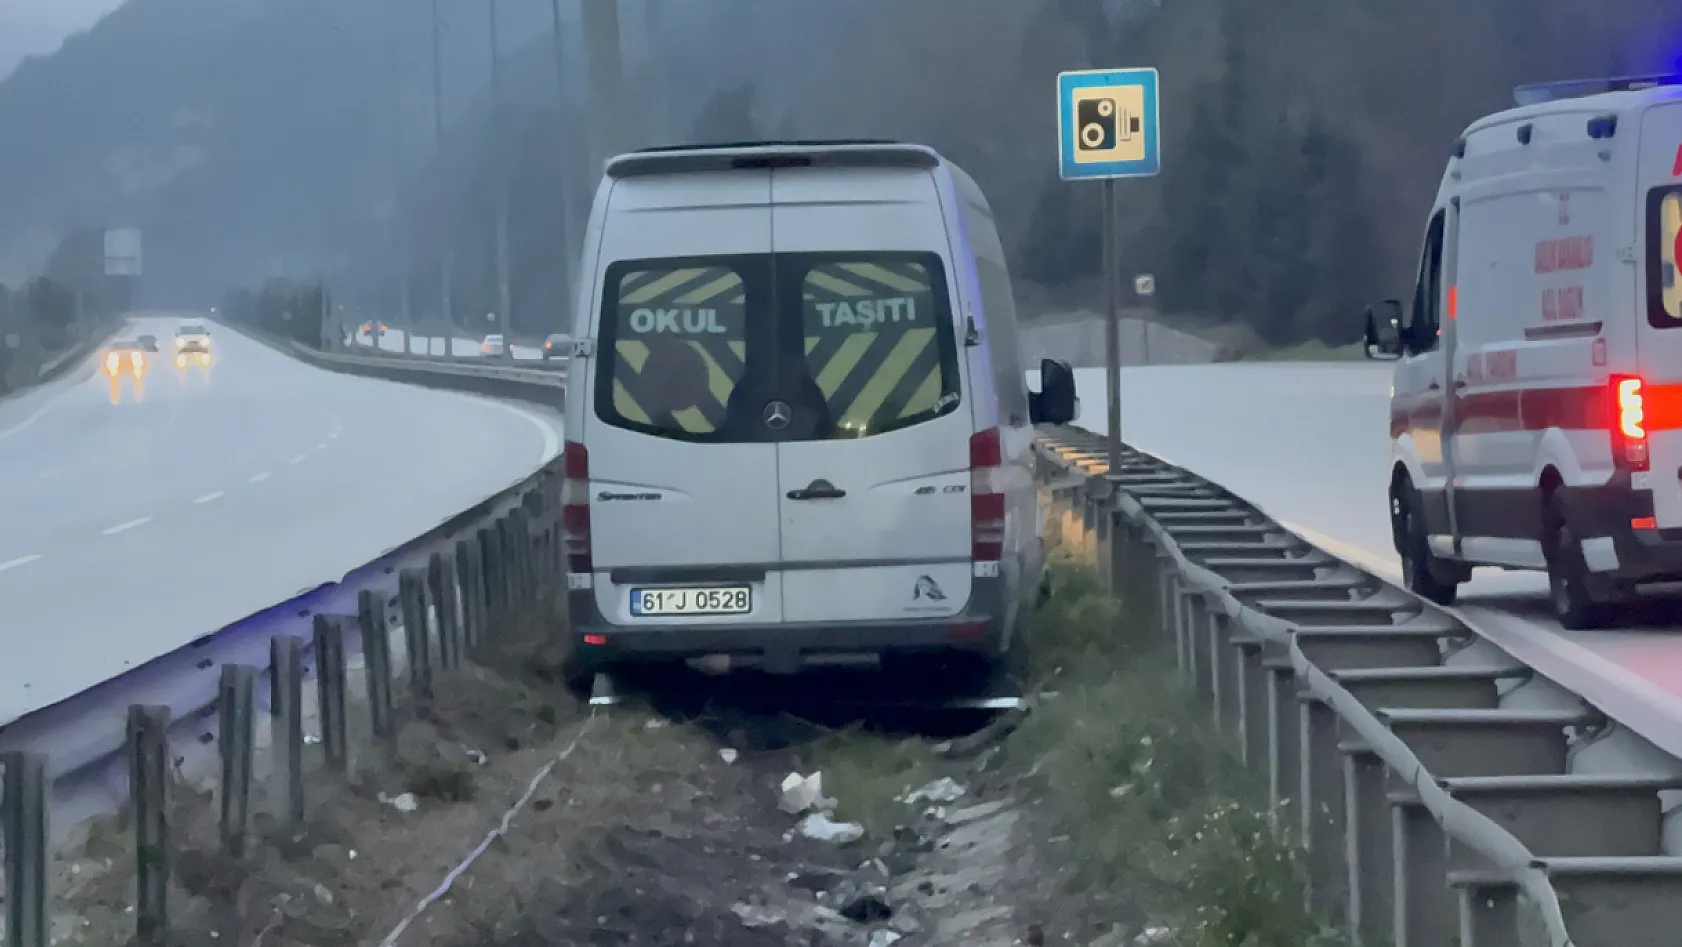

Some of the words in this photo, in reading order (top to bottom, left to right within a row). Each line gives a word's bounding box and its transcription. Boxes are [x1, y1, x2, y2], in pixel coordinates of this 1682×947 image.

[630, 308, 727, 333] OKUL
[815, 297, 916, 331] TAŞITI
[643, 592, 663, 610] 61
[675, 591, 686, 610] J
[696, 590, 747, 609] 0528
